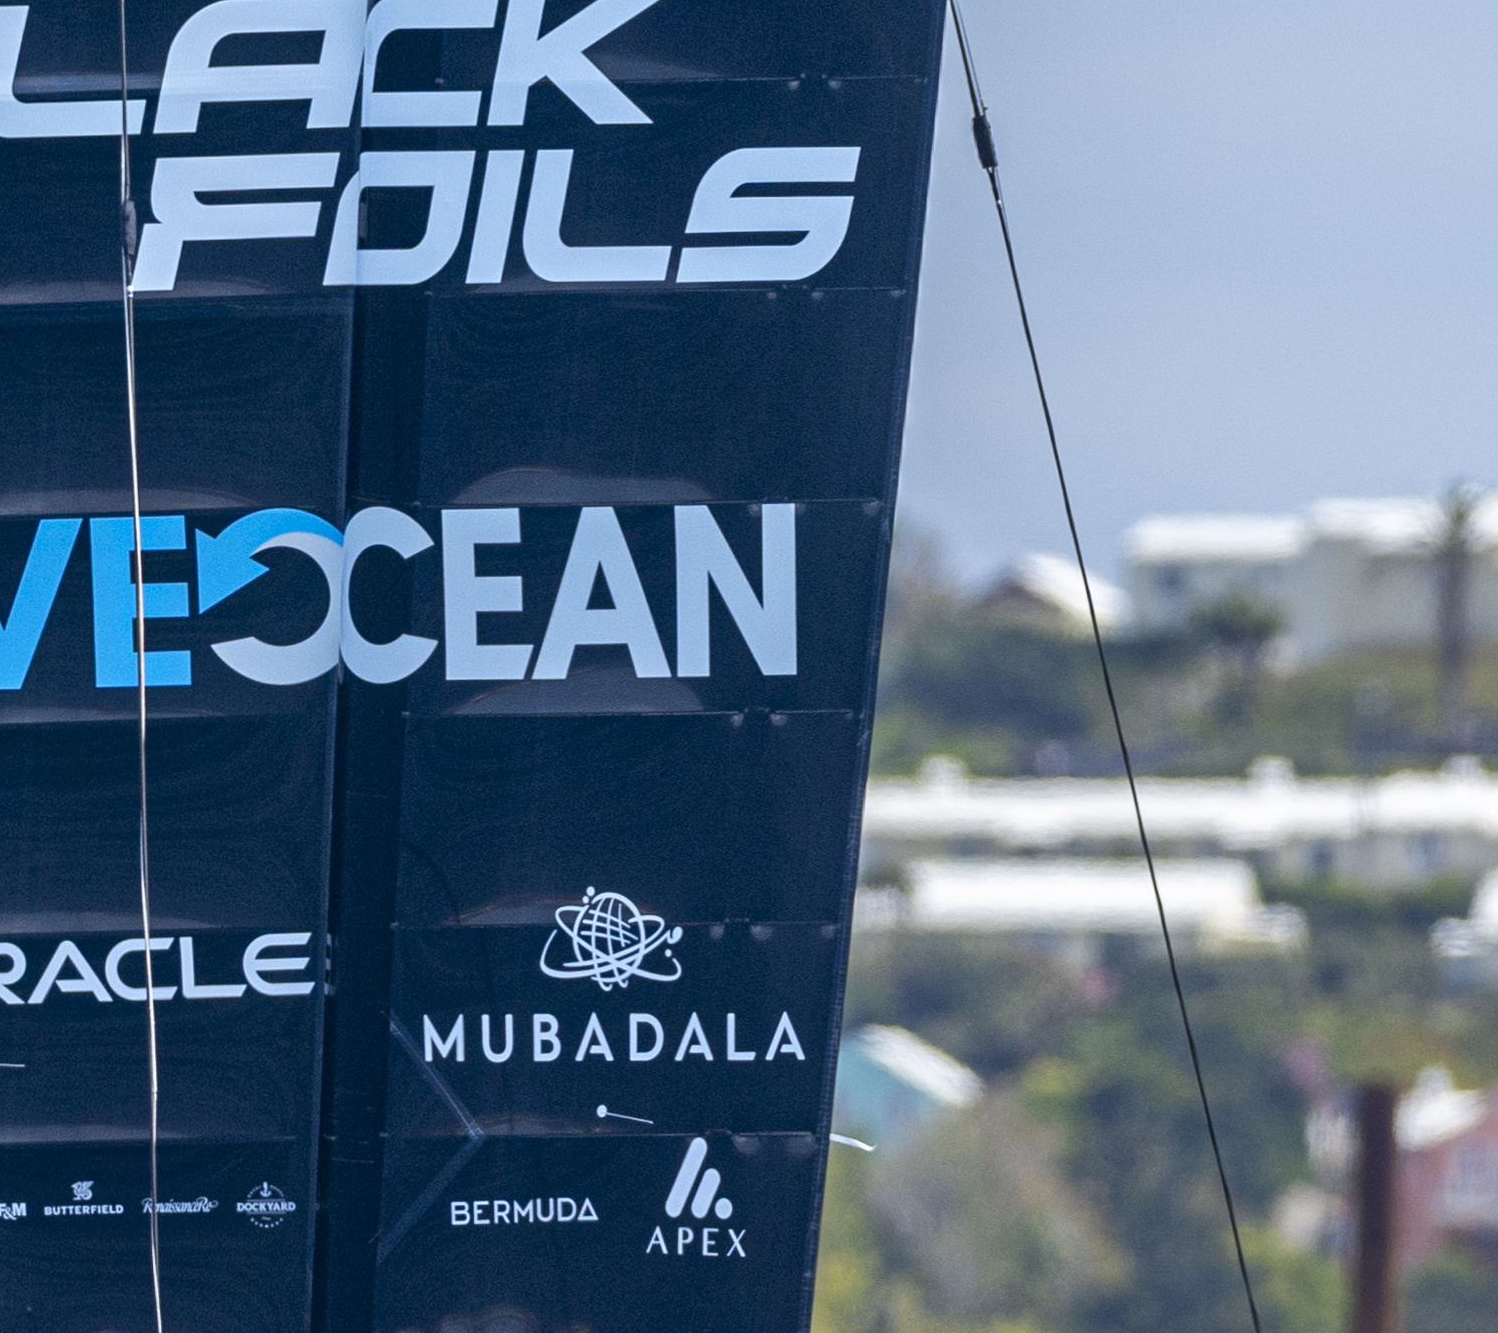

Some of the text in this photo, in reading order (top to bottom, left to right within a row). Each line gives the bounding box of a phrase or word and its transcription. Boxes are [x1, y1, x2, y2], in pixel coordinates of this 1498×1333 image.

[127, 146, 861, 292] FOILS
[422, 1011, 806, 1063] MUBADALA
[43, 1204, 125, 1216] BUTTERFIELD
[235, 1200, 297, 1214] DOCKYARD
[450, 1197, 600, 1226] BERMUDA
[645, 1225, 747, 1258] APEX
